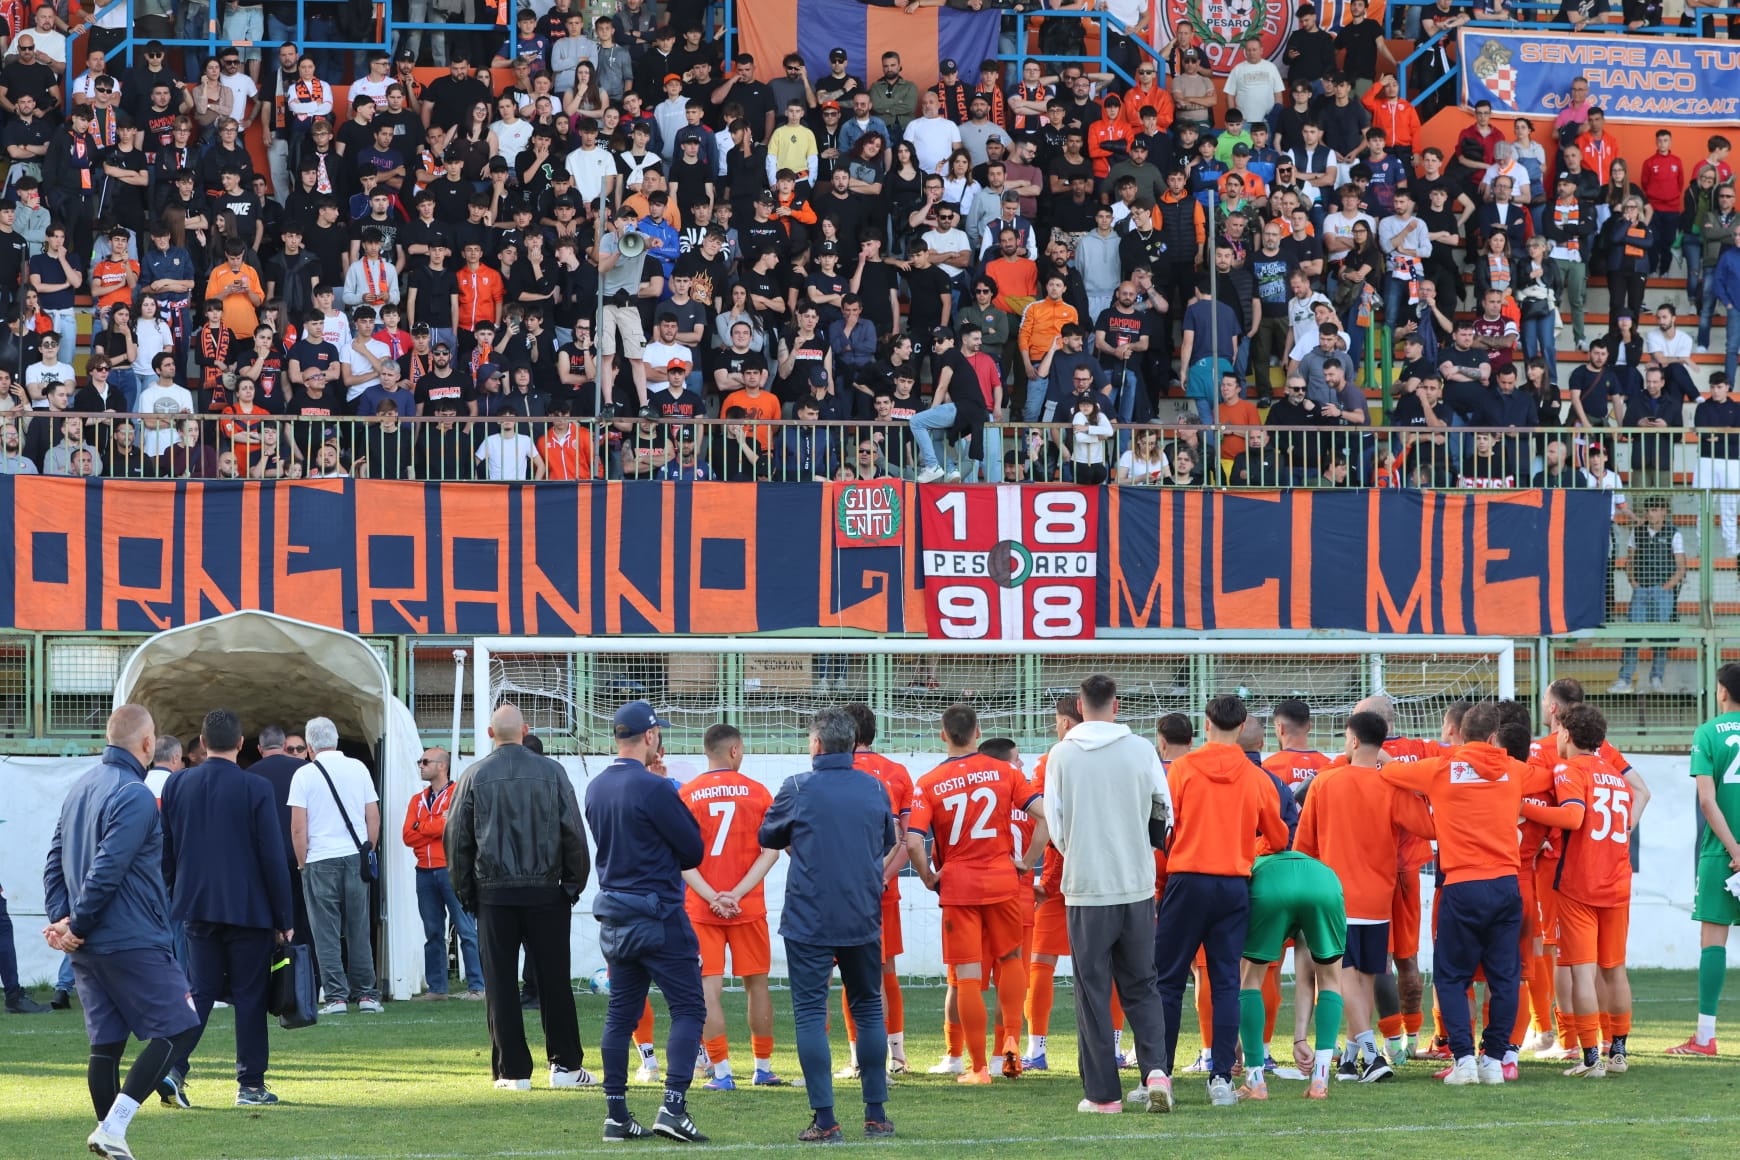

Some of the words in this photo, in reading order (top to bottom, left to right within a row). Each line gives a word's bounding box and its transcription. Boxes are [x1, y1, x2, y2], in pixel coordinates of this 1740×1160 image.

[1206, 18, 1251, 28] PESARO
[1201, 42, 1247, 66] 97
[1520, 42, 1647, 67] SEMPRE
[1651, 49, 1691, 68] AL
[1583, 68, 1697, 93] FIANCO
[1541, 92, 1612, 111] CURI
[1615, 96, 1737, 114] ARANCIONI
[226, 202, 252, 215] NIKE
[1109, 317, 1141, 329] CAMPIONI
[1367, 488, 1567, 635] MIEI
[933, 776, 966, 796] COSTA
[966, 770, 1000, 785] PISANI
[1593, 772, 1626, 788] CUOMO
[690, 785, 749, 802] KHARMOUD
[942, 787, 998, 846] 72
[1590, 787, 1630, 844] 35
[708, 801, 736, 857] 7
[665, 1093, 683, 1104] 37
